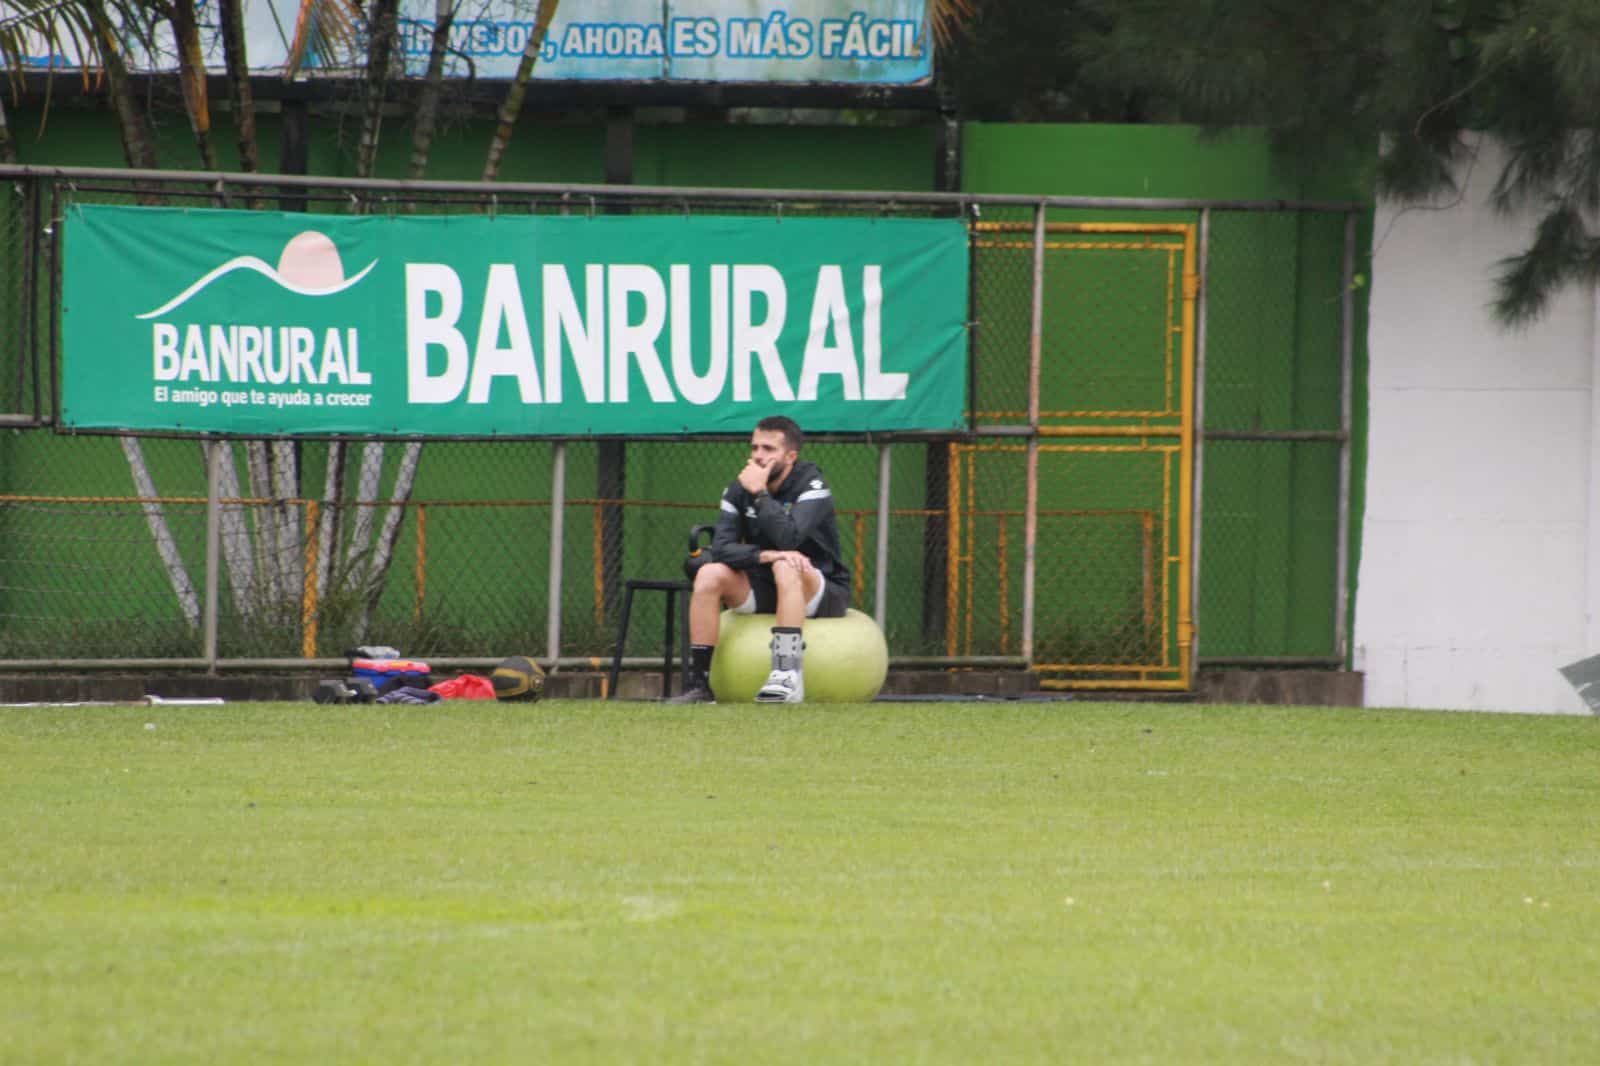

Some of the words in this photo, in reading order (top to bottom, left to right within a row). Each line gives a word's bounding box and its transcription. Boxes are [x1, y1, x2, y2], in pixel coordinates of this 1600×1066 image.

[561, 25, 664, 56] AHORA
[672, 19, 720, 56] ES
[728, 13, 812, 57] MÁS
[822, 14, 924, 57] FÁCIL
[153, 322, 372, 385] BANRURAL
[405, 263, 909, 405] BANRURAL
[153, 385, 168, 403] El
[171, 386, 218, 407] amigo
[221, 390, 248, 407] que
[250, 388, 266, 405] te
[268, 388, 311, 409] ayuda
[313, 392, 323, 406] a
[326, 392, 372, 406] crecer
